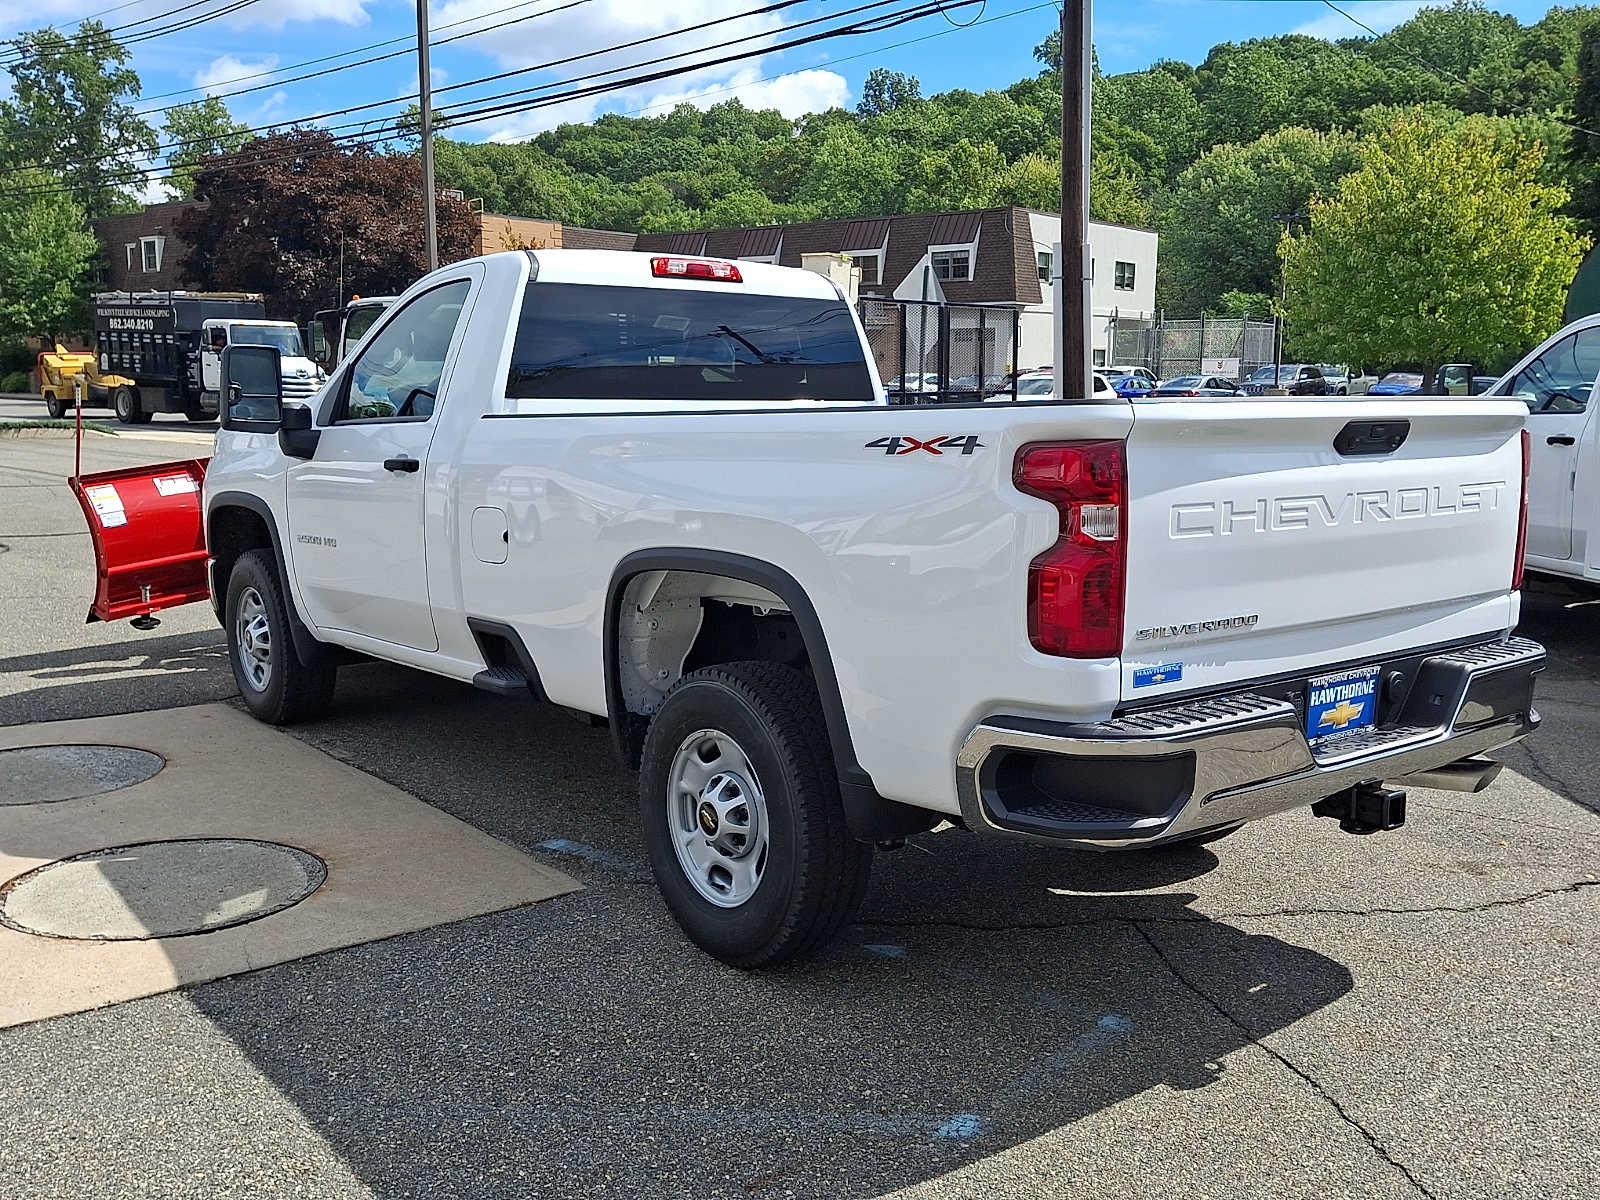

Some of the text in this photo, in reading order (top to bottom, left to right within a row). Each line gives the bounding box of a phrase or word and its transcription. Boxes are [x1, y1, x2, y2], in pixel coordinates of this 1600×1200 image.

[1168, 481, 1506, 539] CHEVROLET
[1136, 614, 1259, 640] SILVERADO
[1136, 664, 1182, 677] HAWTHORNE
[1310, 679, 1376, 706] HAWTHORNE
